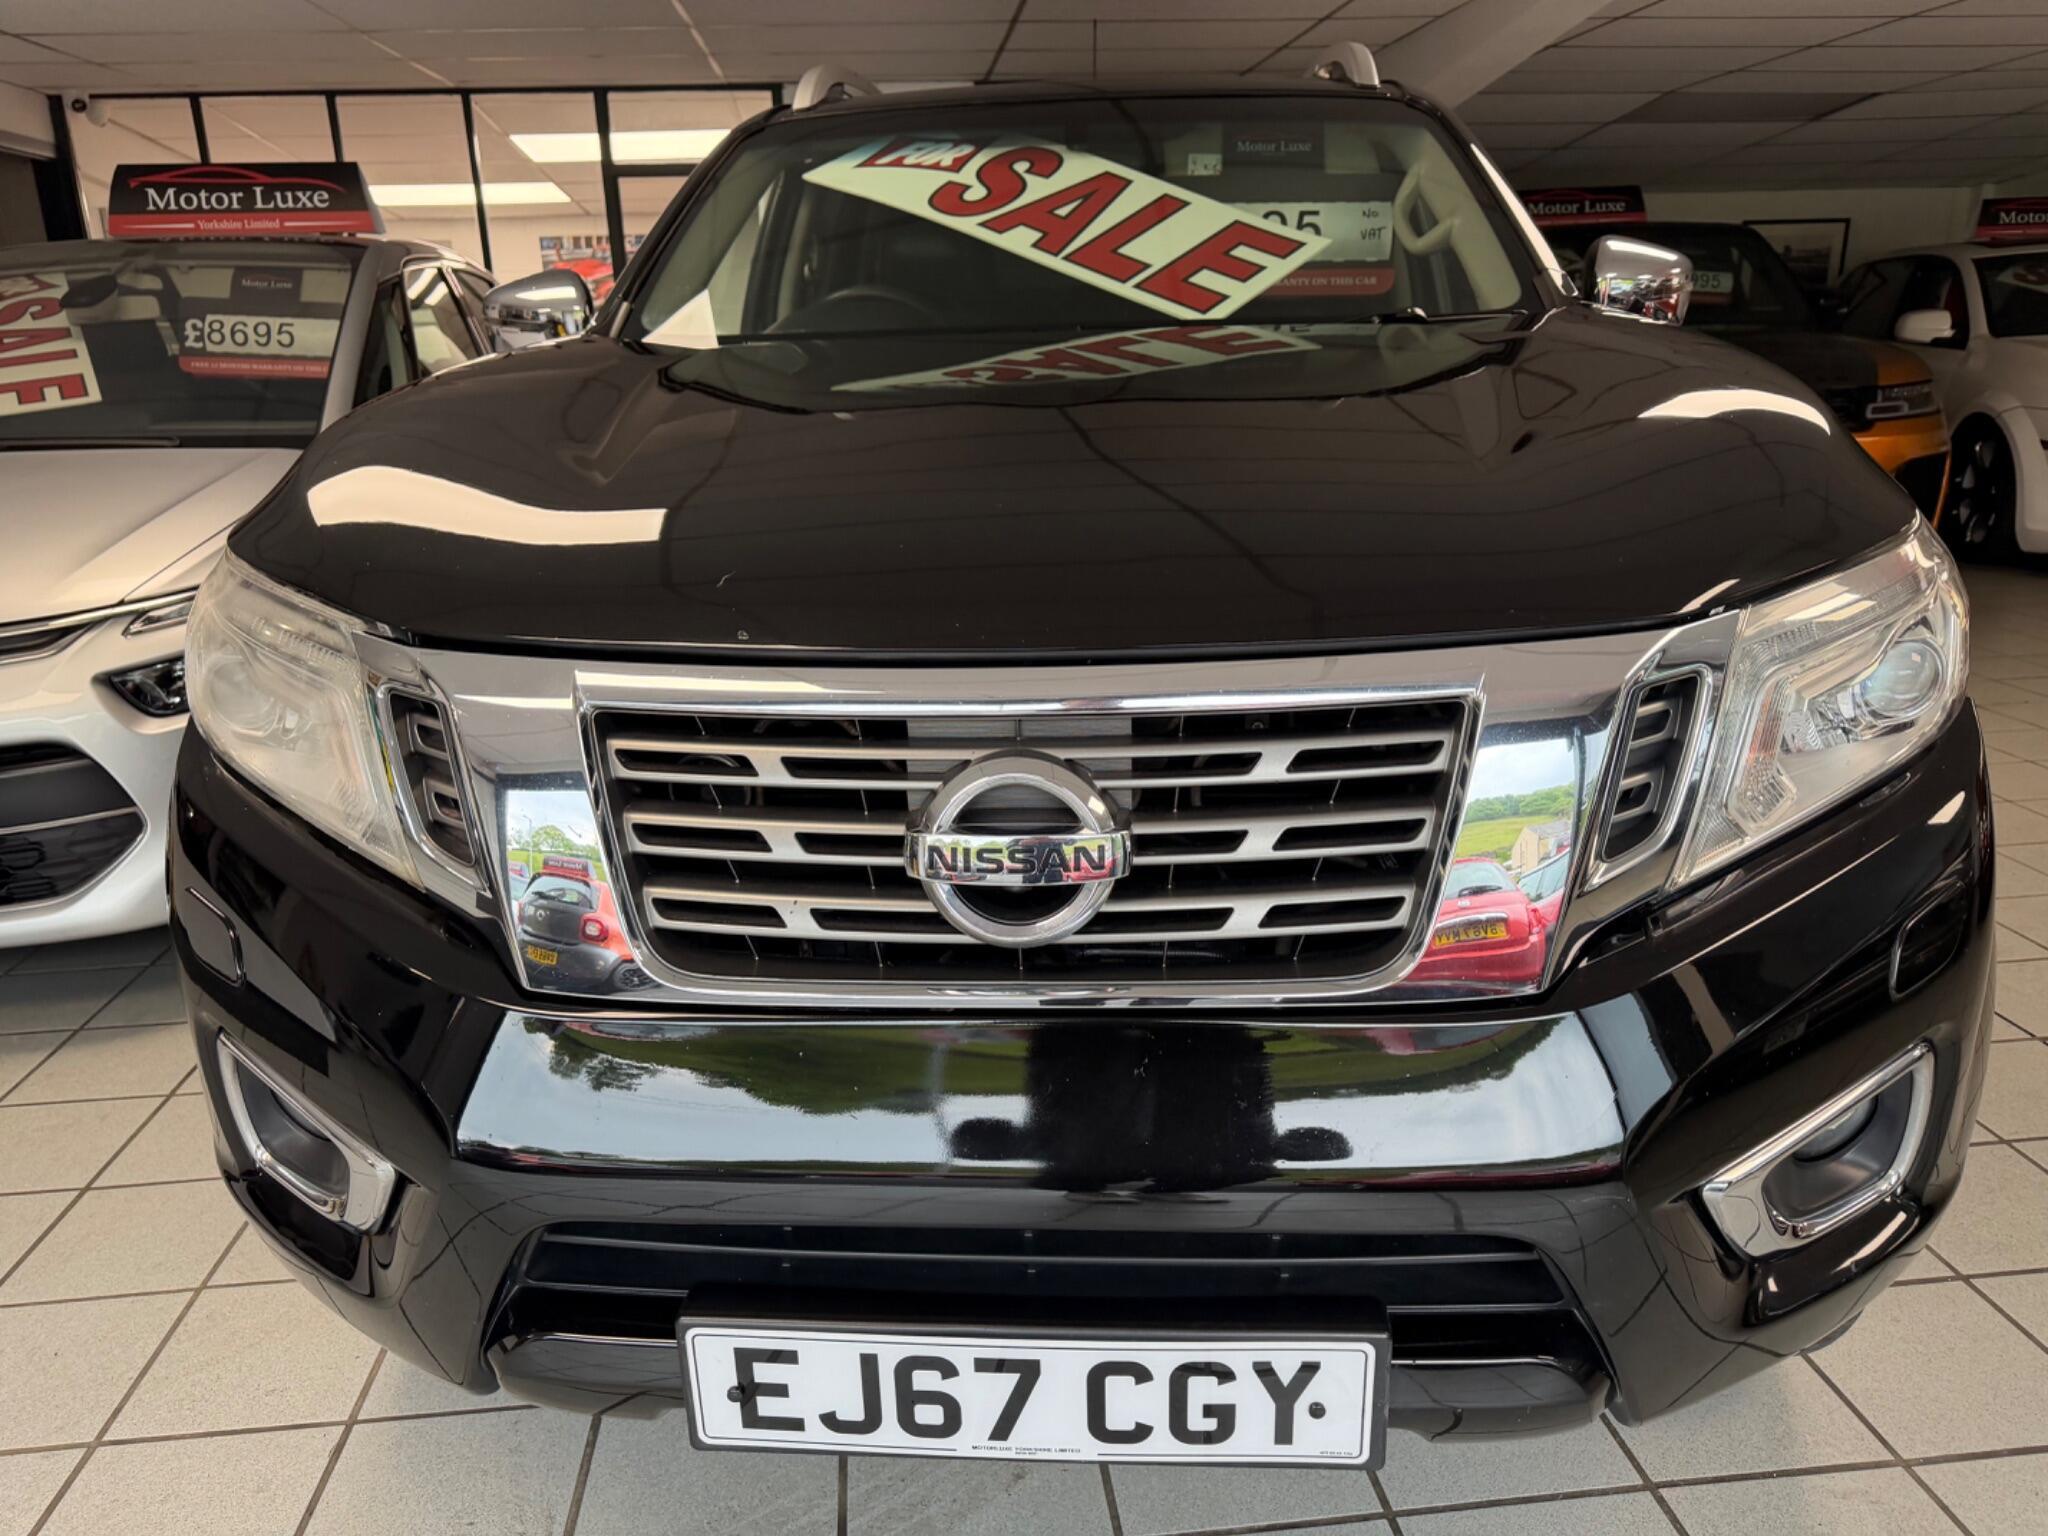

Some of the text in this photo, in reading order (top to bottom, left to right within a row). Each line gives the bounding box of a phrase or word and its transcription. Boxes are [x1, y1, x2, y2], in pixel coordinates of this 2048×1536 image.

[1236, 140, 1313, 152] Motor Luxe
[144, 186, 330, 211] Motor Luxe
[1362, 207, 1379, 219] No
[1527, 200, 1626, 215] Motor Luxe
[197, 218, 281, 230] Yorkshire Limited
[2000, 211, 2048, 224] Moto
[874, 141, 1307, 315] FOR SALE
[1360, 226, 1386, 241] VAT
[1312, 275, 1328, 286] ON
[1329, 275, 1354, 286] THIS
[1355, 275, 1378, 286] CAR
[184, 318, 295, 349] £8695
[926, 844, 1107, 874] NISSAN
[733, 1346, 1322, 1446] EJ67 CGY
